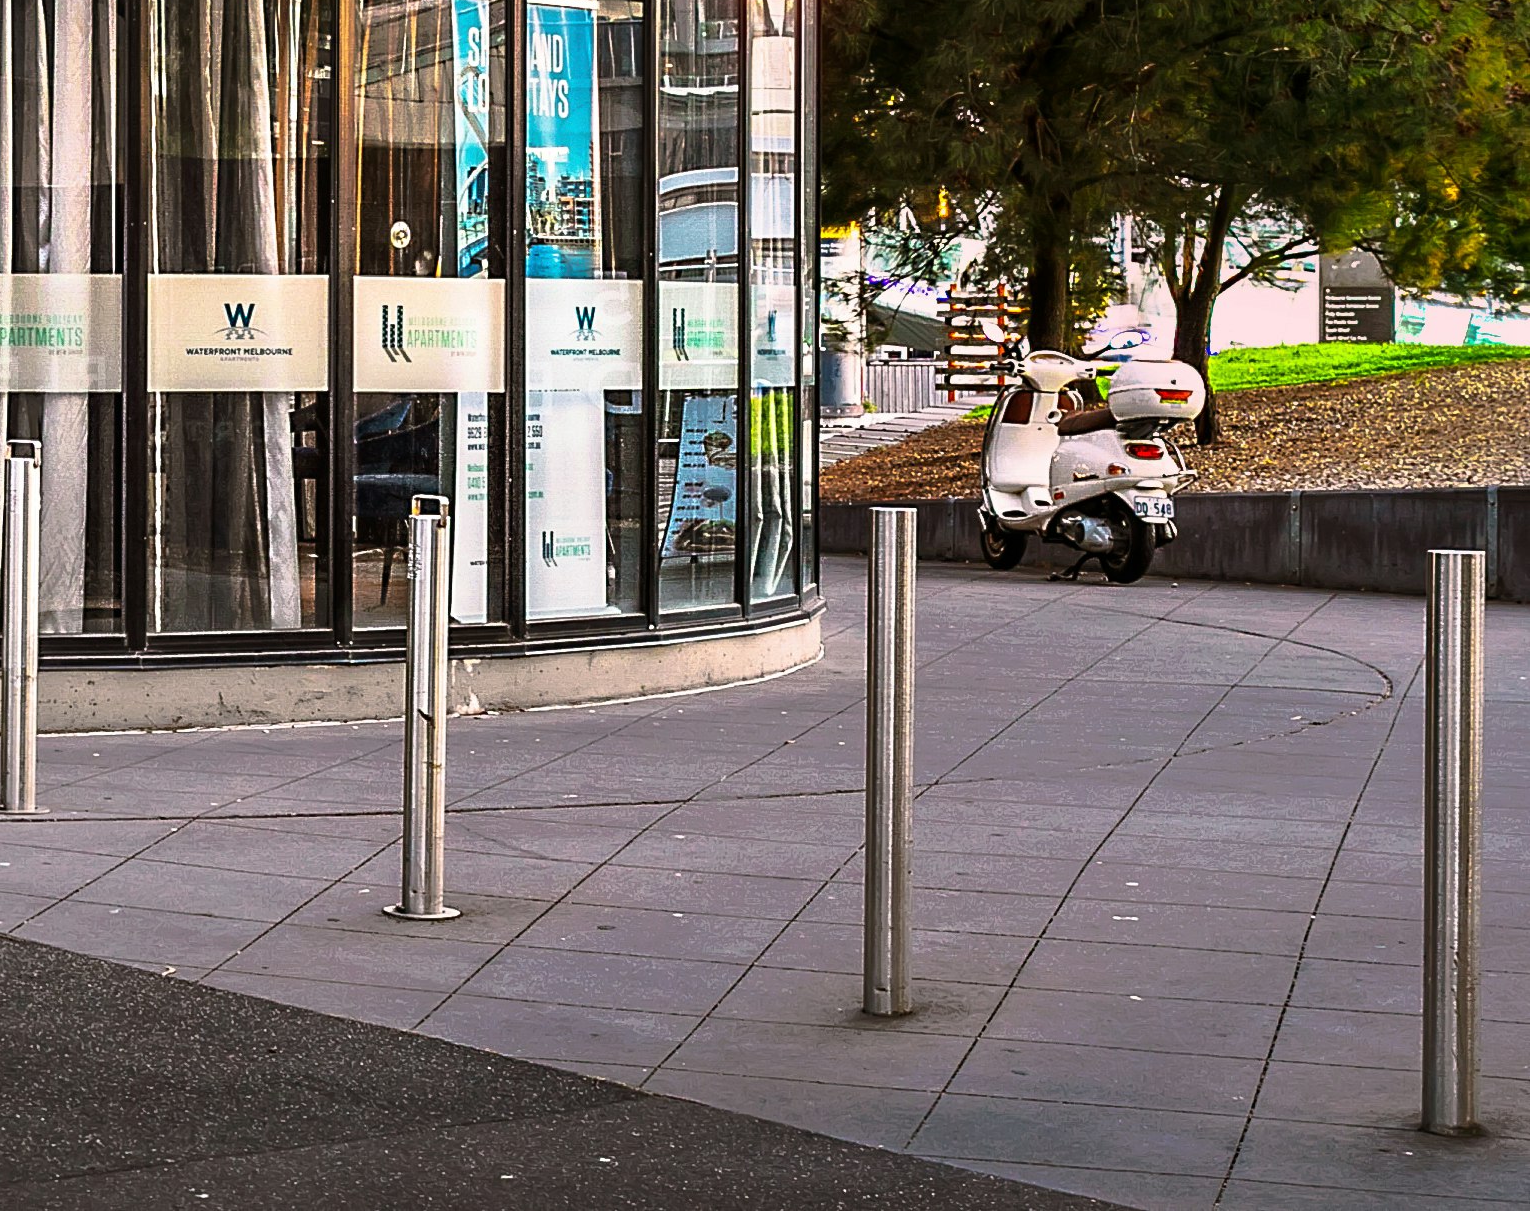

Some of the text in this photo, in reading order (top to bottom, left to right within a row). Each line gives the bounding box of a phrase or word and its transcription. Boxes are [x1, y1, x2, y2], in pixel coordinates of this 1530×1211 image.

[530, 31, 564, 73] AND
[529, 78, 570, 119] TAYS
[224, 303, 256, 328] W
[575, 306, 596, 330] W
[406, 329, 478, 349] APARTMENTS
[186, 348, 293, 356] WATERFRONT MELBOURNE
[1153, 502, 1172, 516] 548
